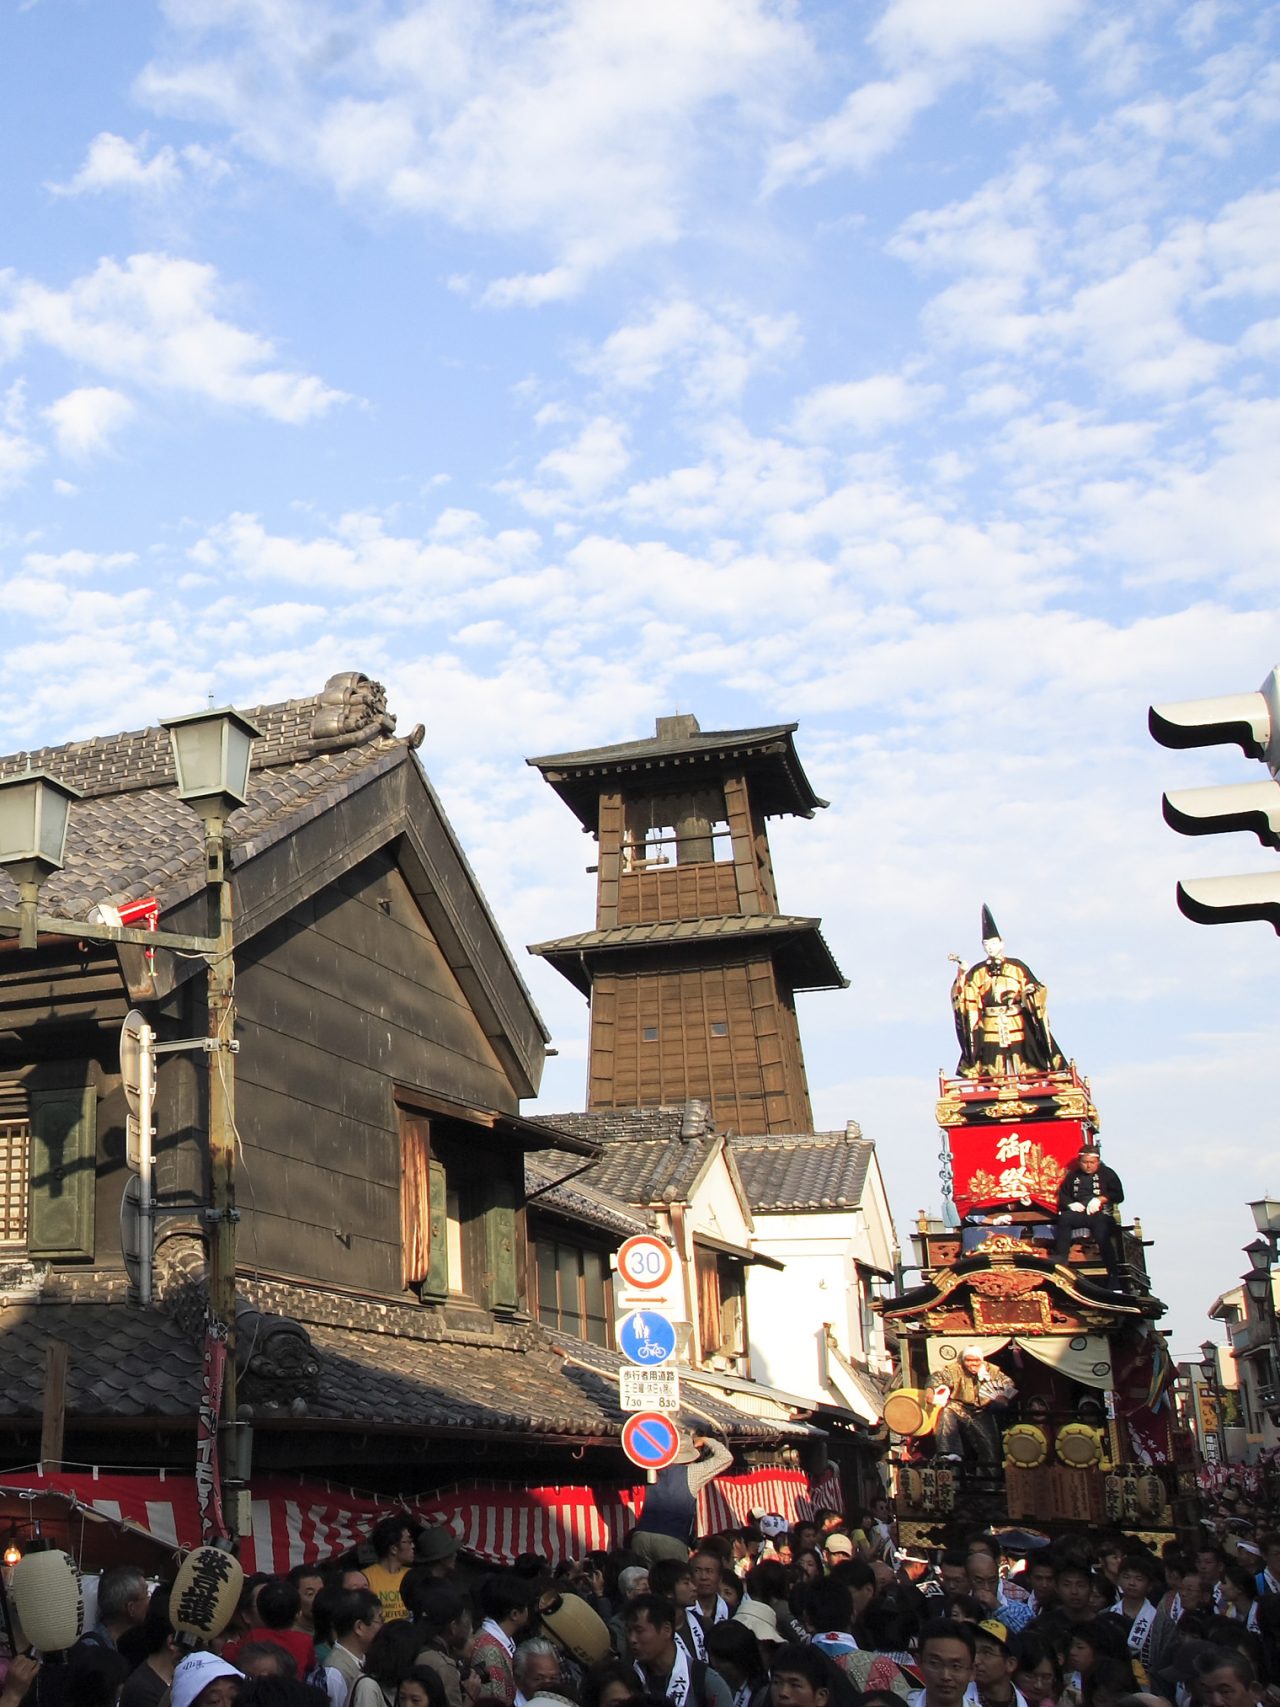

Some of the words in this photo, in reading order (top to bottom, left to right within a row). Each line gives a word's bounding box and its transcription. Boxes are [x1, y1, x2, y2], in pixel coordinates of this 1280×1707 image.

[995, 1132, 1035, 1207] 御祭
[630, 1251, 661, 1275] 30
[624, 1370, 675, 1381] 歩行者用道路
[177, 1549, 233, 1632] 警護
[1130, 1617, 1149, 1646] 六軒町
